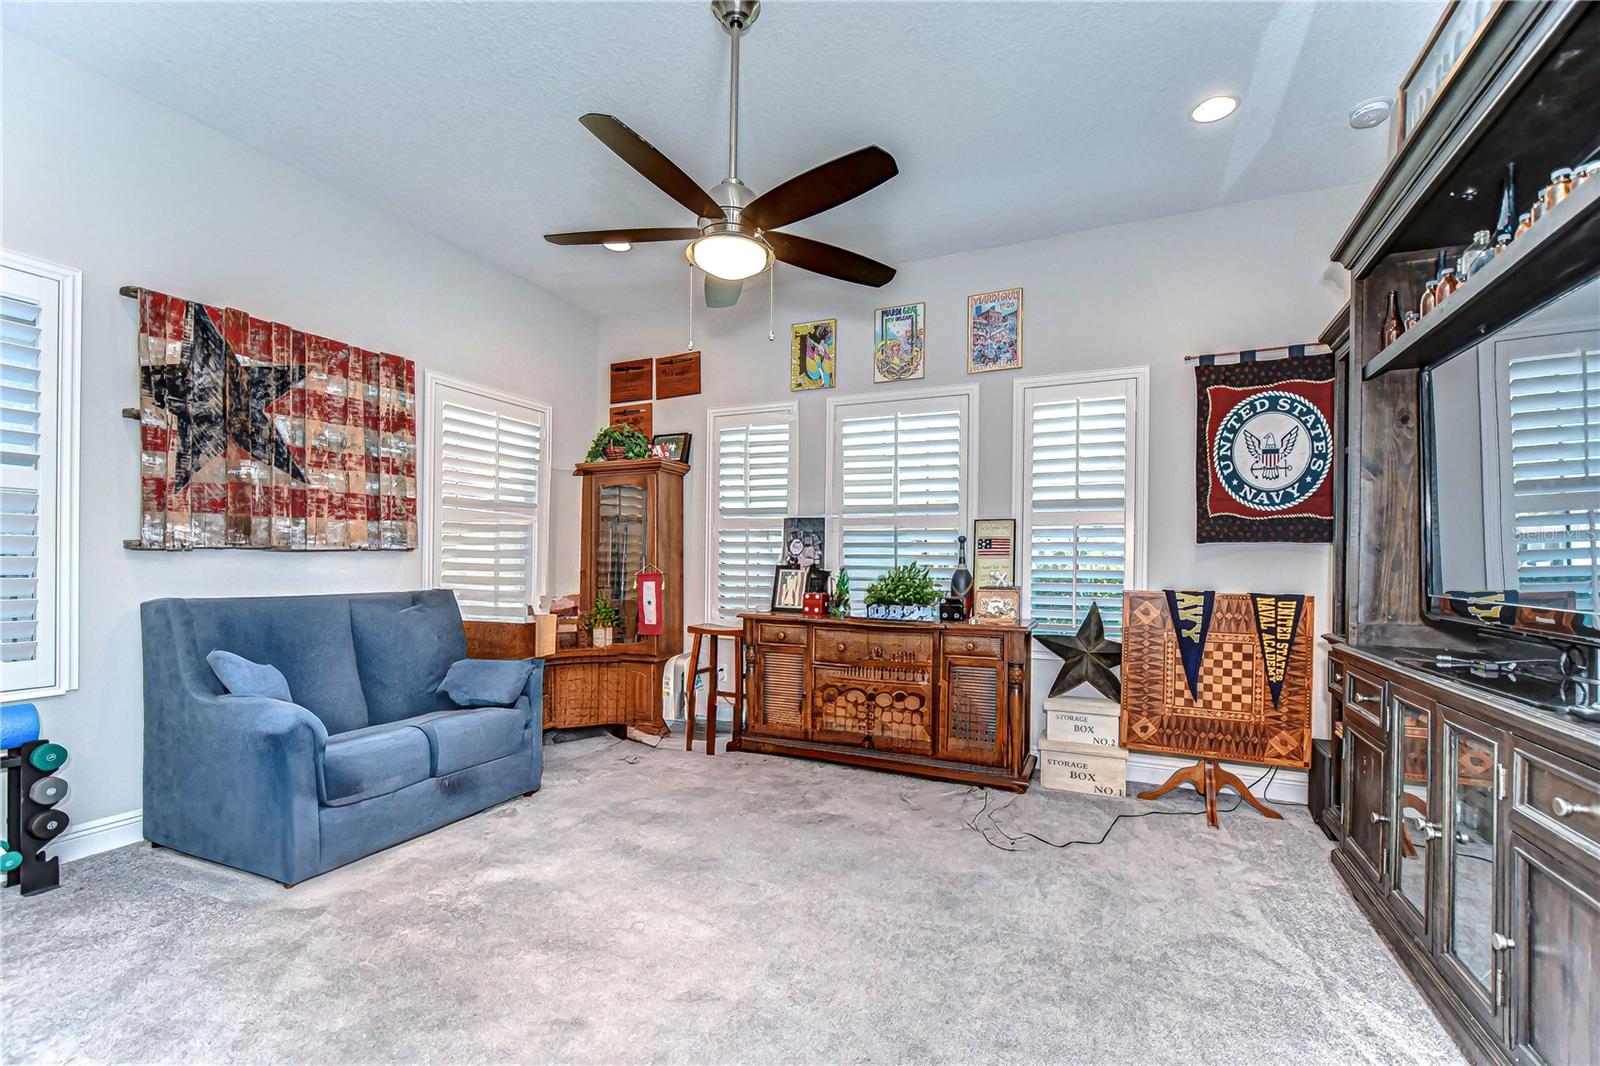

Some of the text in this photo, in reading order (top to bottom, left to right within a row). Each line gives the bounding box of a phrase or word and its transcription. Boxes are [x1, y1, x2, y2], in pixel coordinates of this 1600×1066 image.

[882, 308, 902, 317] MARDI
[1219, 398, 1326, 476] UNITED STATES
[1239, 482, 1301, 504] NAVY
[1256, 597, 1277, 683] NAVAL ACADEMY
[1275, 600, 1297, 681] UNITED STATES
[1056, 714, 1089, 723] STORAGE
[1074, 724, 1095, 734] BOX
[1092, 736, 1116, 747] NO.2
[1047, 759, 1089, 770] STORAGE
[1070, 771, 1096, 782] BOX
[1094, 785, 1122, 797] NO.1
